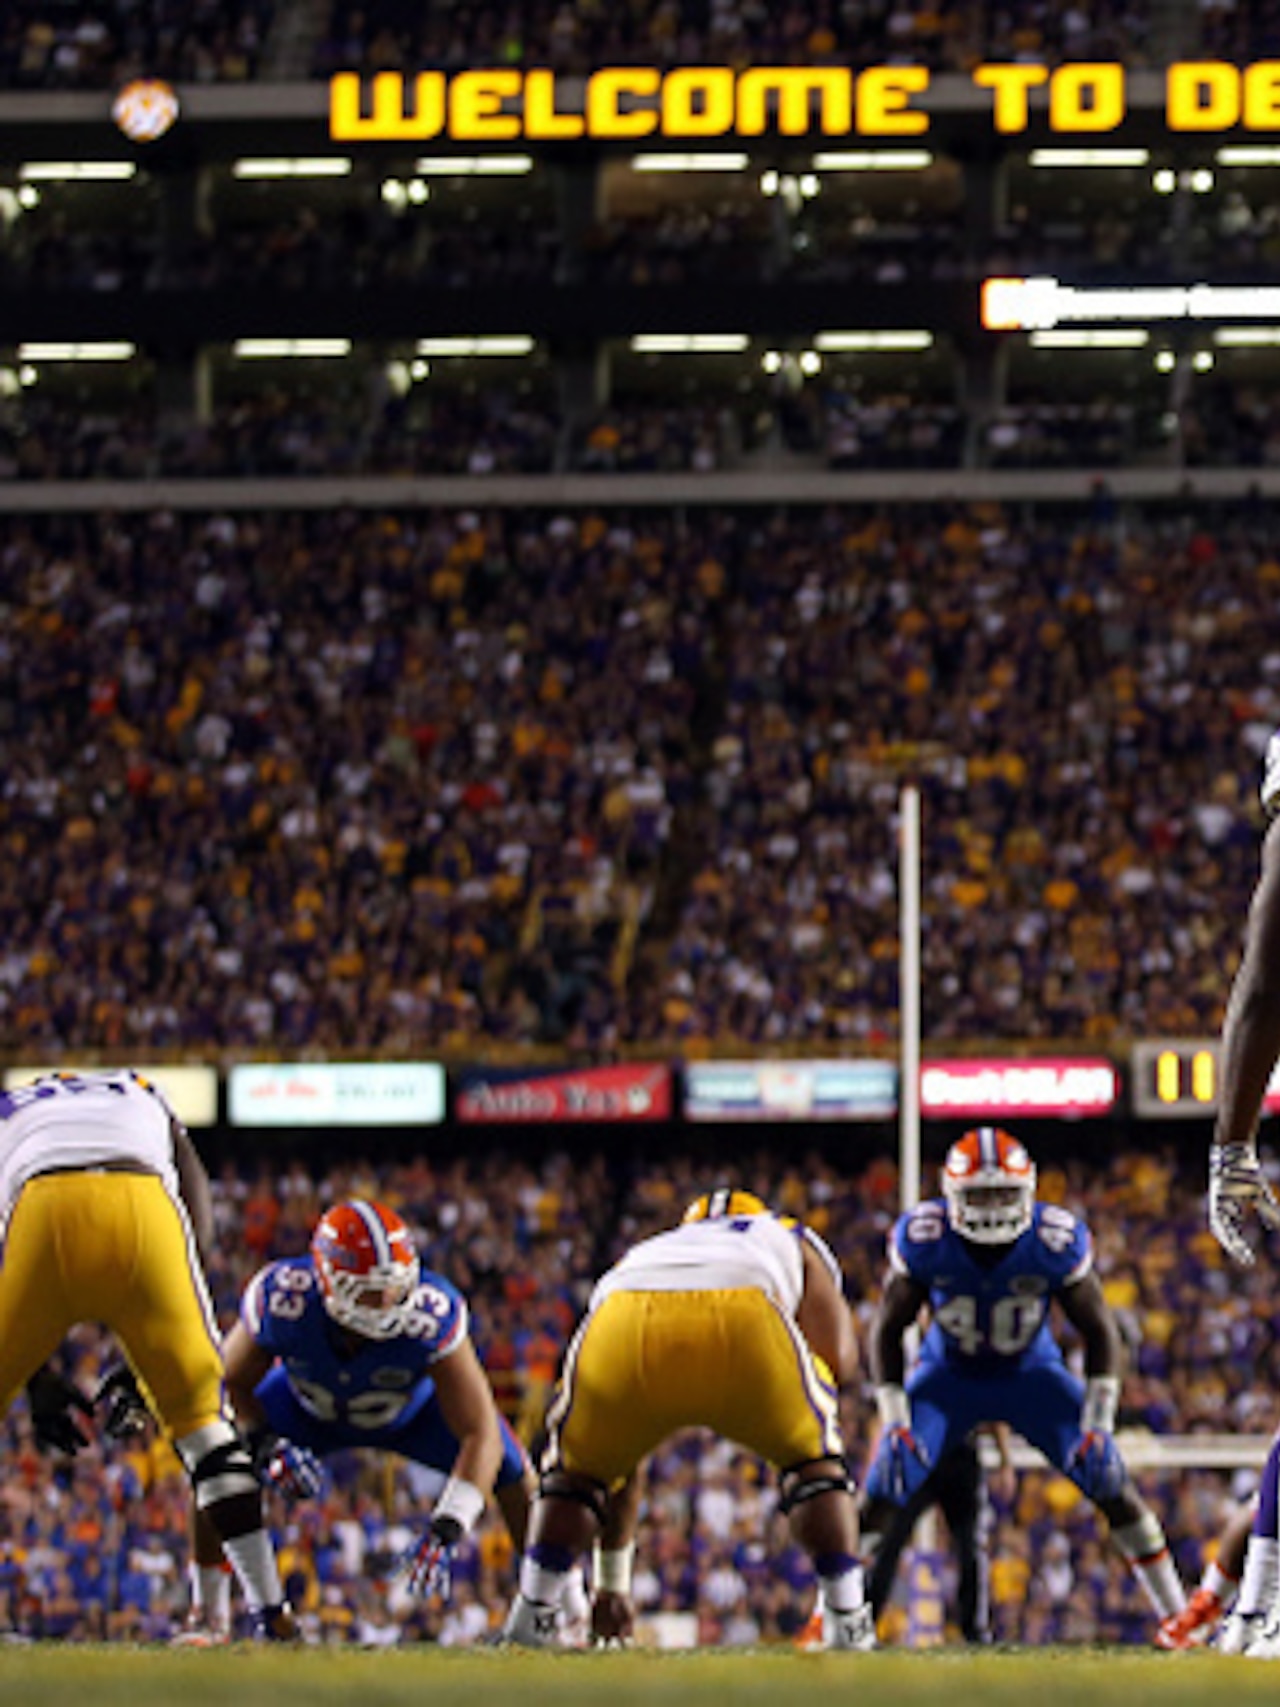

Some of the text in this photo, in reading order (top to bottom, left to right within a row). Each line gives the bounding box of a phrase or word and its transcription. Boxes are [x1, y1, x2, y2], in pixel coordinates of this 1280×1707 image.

[330, 67, 928, 139] WELCOME
[974, 63, 1124, 131] TO
[936, 1295, 1043, 1355] 40
